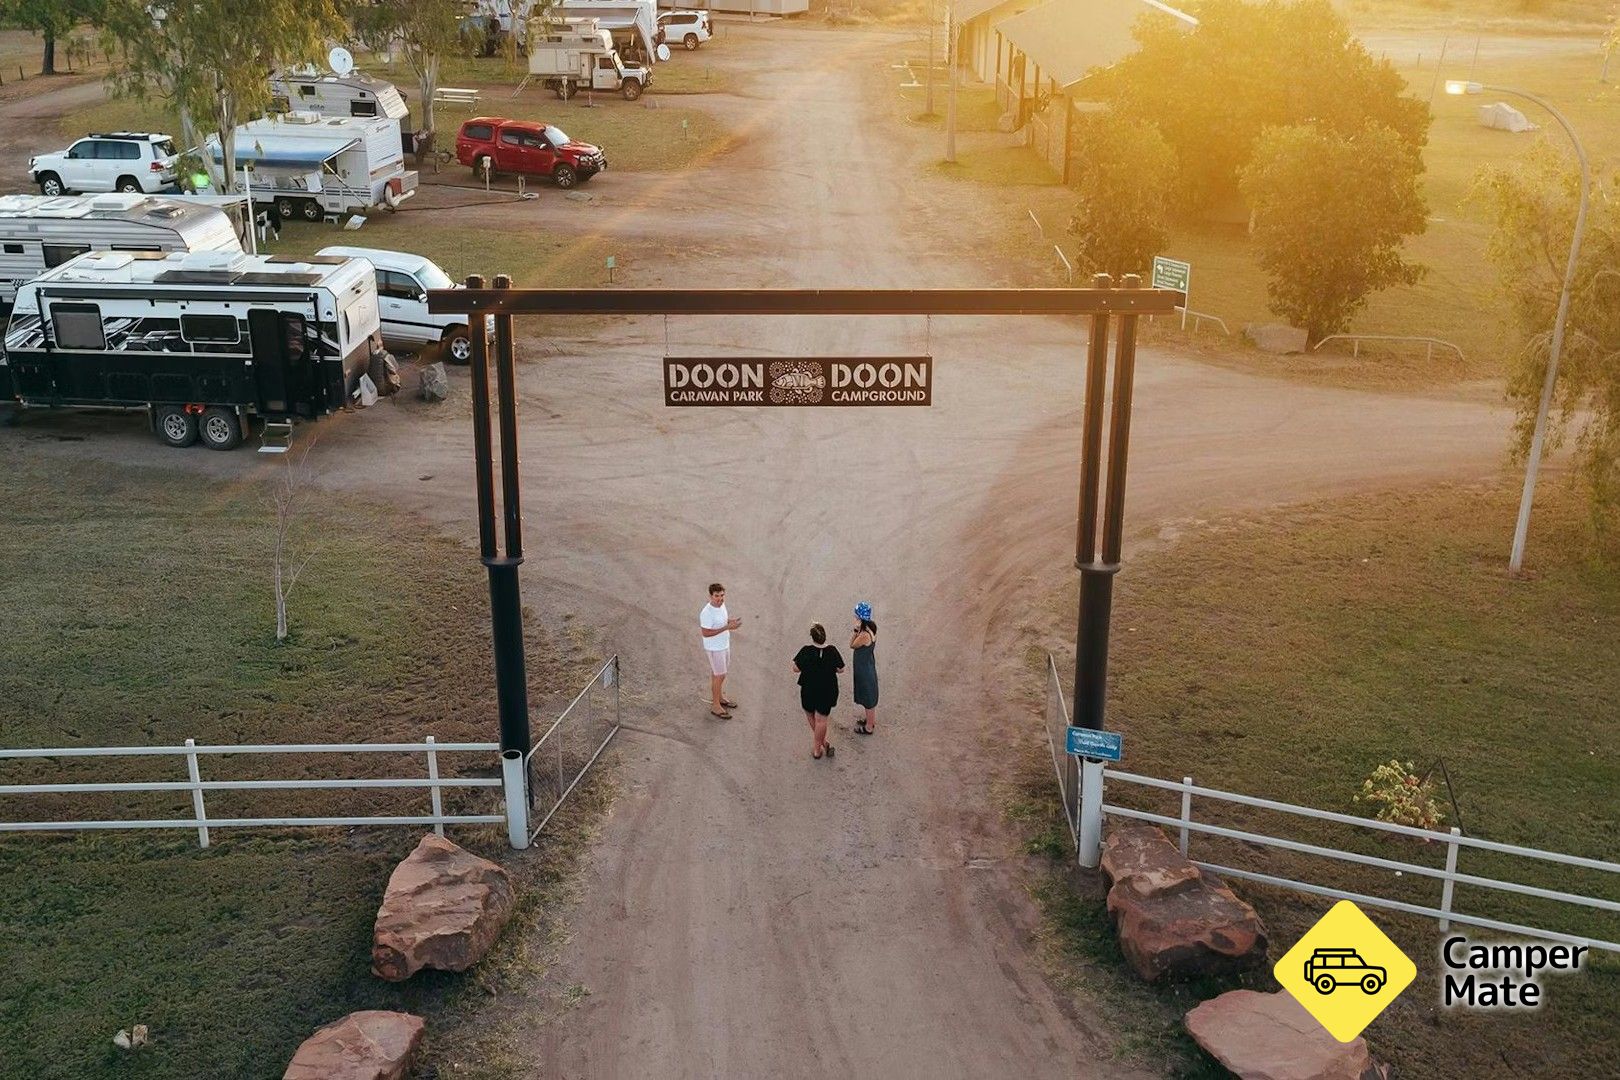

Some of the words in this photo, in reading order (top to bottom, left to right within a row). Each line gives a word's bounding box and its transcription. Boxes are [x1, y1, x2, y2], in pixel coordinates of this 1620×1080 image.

[668, 363, 764, 388] DOON
[831, 363, 927, 388] DOON
[670, 390, 727, 402] CARAVAN
[733, 390, 764, 402] PARK
[831, 390, 926, 402] CAMPGROUND
